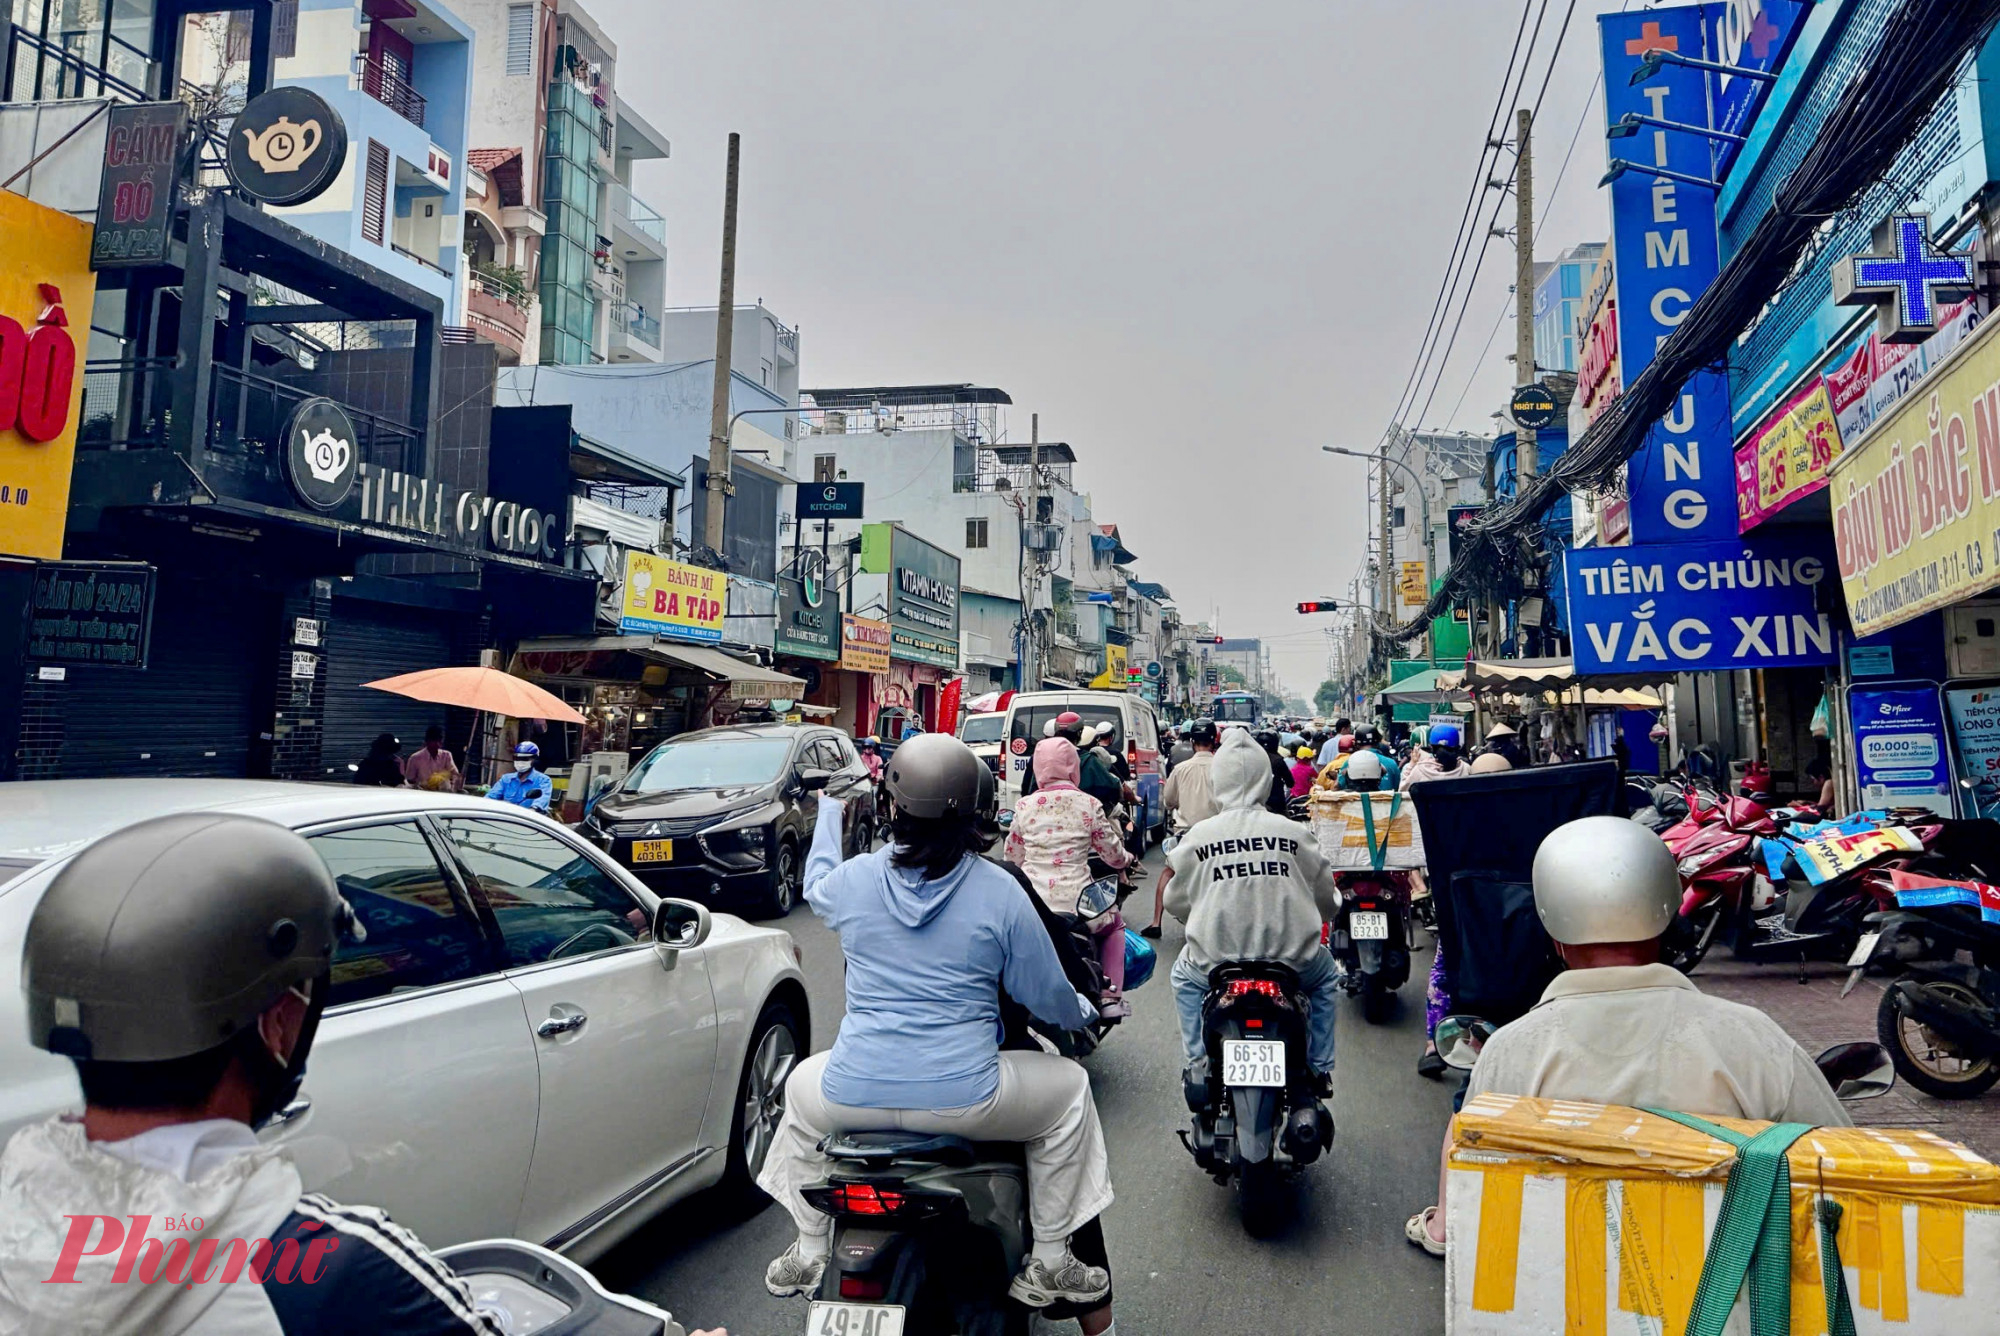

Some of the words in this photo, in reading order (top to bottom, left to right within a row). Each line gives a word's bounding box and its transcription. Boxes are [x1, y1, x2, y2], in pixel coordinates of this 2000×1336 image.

[1836, 480, 1879, 590] ĐẬU
[1877, 440, 1912, 559] HŨ
[1912, 393, 1971, 539] BẮC
[810, 503, 847, 511] KITCHEN
[667, 567, 698, 588] BÁNH
[701, 574, 713, 591] MÌ
[1580, 559, 1664, 596] TIÊM
[1677, 549, 1824, 592] CHỦNG
[95, 582, 141, 613] 24/24
[901, 567, 930, 599] VITAMIN
[930, 579, 955, 608] HOUSE
[653, 589, 679, 616] BA
[686, 593, 720, 626] TẬP
[798, 610, 825, 628] KITCHEN
[1585, 599, 1713, 662] VẮC
[1730, 613, 1833, 658] XIN
[1965, 706, 1985, 718] TIÊM
[1958, 718, 1994, 732] LONG
[1868, 741, 1909, 751] 10.000
[636, 852, 668, 861] 403.61
[643, 841, 662, 851] 51H
[1195, 837, 1299, 862] WHENEVER
[1213, 861, 1290, 882] ATELIER
[1356, 914, 1381, 926] 85-B1
[1353, 925, 1386, 938] 632.81
[1233, 1045, 1274, 1062] 66-S1
[1228, 1065, 1282, 1083] 237.06
[1626, 1209, 1642, 1242] LƯỢNG
[1637, 1244, 1650, 1271] CHẤT
[1648, 1272, 1662, 1305] GIỐNG
